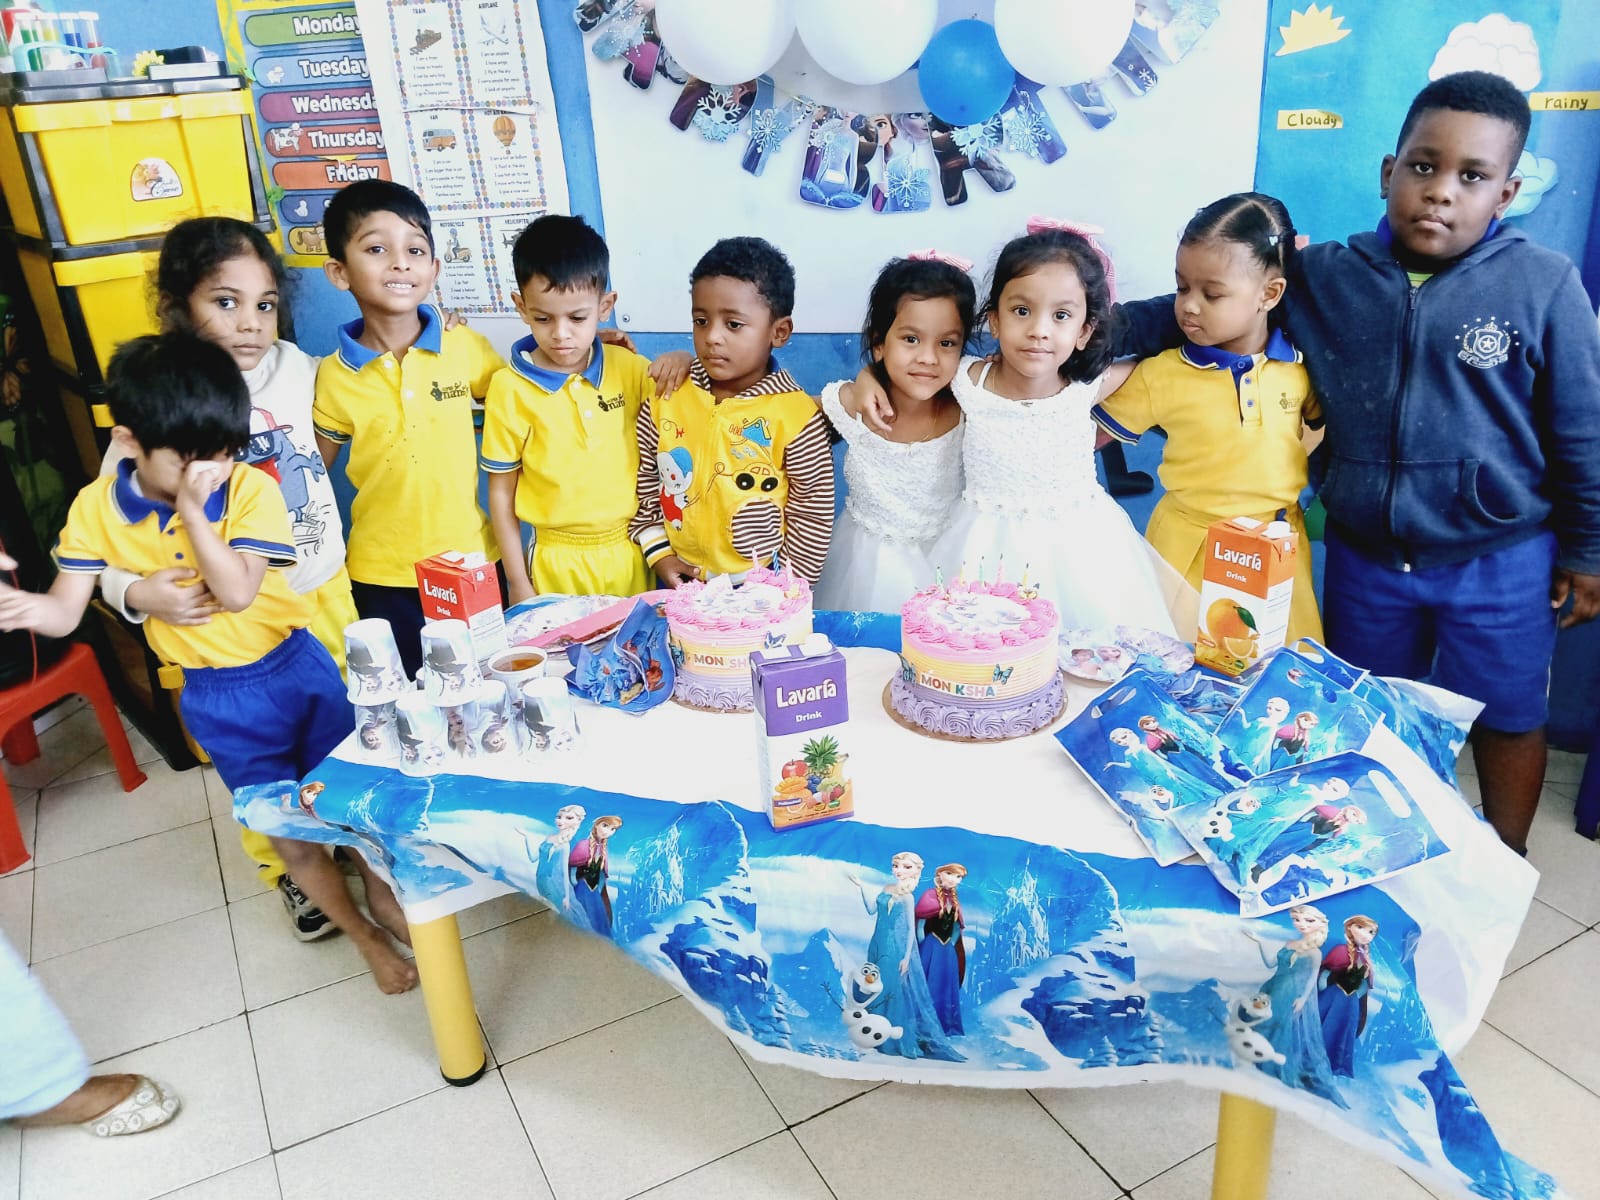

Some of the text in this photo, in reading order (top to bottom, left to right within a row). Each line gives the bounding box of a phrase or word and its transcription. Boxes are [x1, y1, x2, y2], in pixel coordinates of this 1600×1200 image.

[298, 55, 369, 78] Tuesday
[1544, 97, 1588, 111] rainy
[1287, 112, 1337, 128] Cloudy
[307, 128, 385, 149] Thursday
[1226, 571, 1247, 583] Drink
[436, 605, 451, 616] Drink
[693, 654, 724, 666] MON
[921, 674, 995, 697] MON KSHA
[795, 711, 822, 723] Drink
